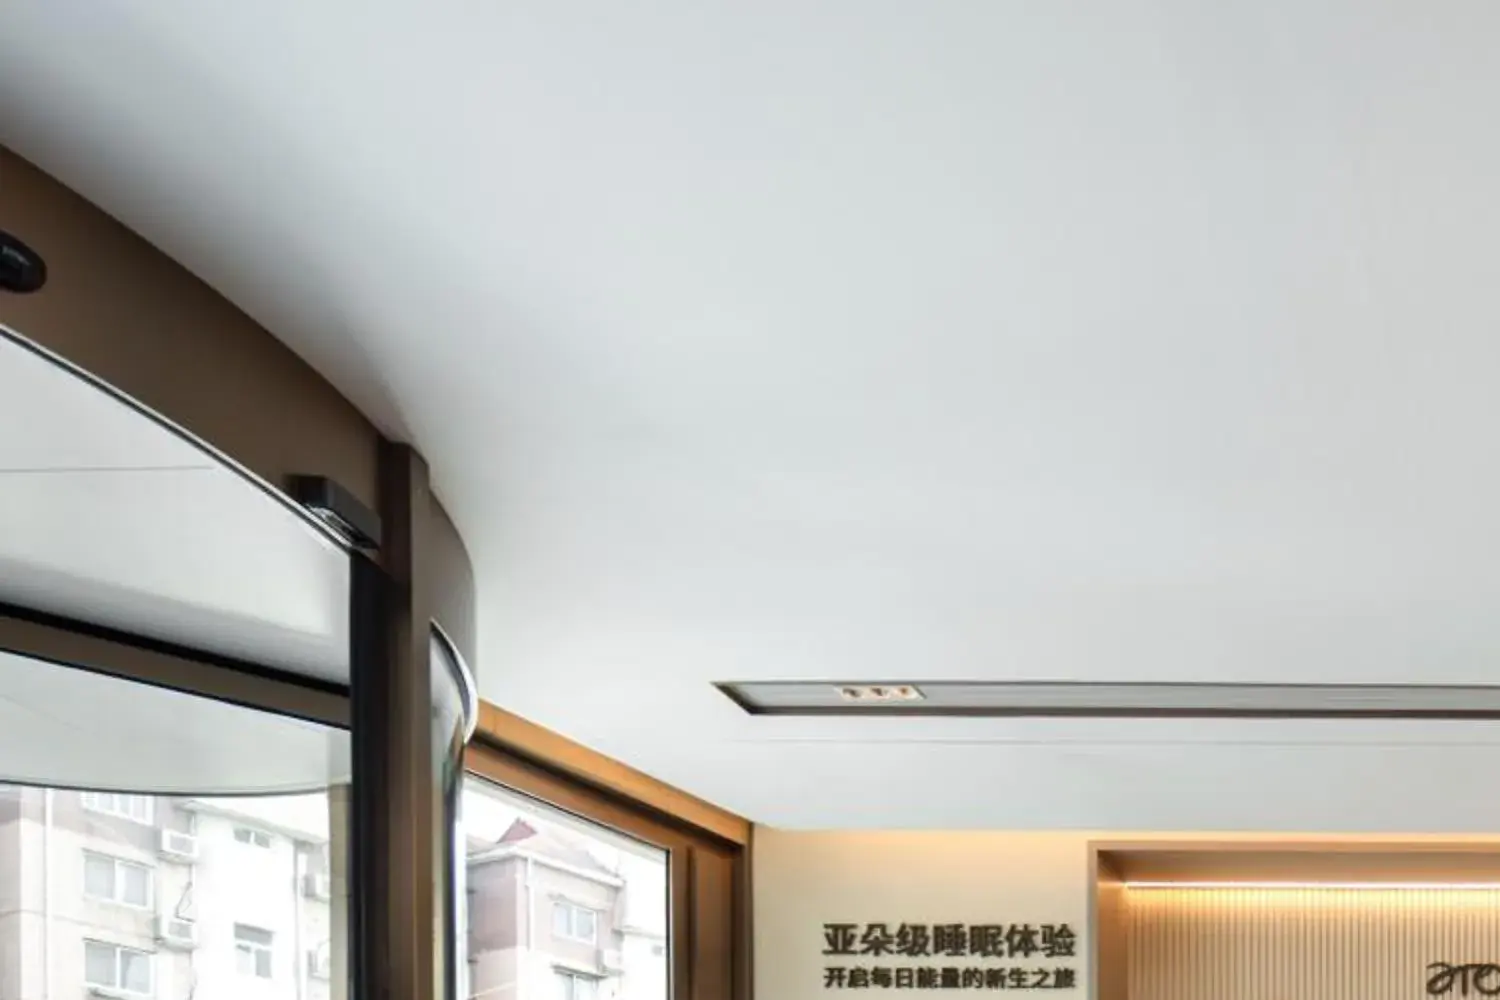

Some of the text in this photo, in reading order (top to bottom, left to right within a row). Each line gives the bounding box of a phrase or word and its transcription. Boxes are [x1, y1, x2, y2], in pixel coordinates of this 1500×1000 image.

[822, 922, 1076, 958] 亚朵级睡眠体验
[823, 966, 1076, 989] 开启每日能量的新生之旅
